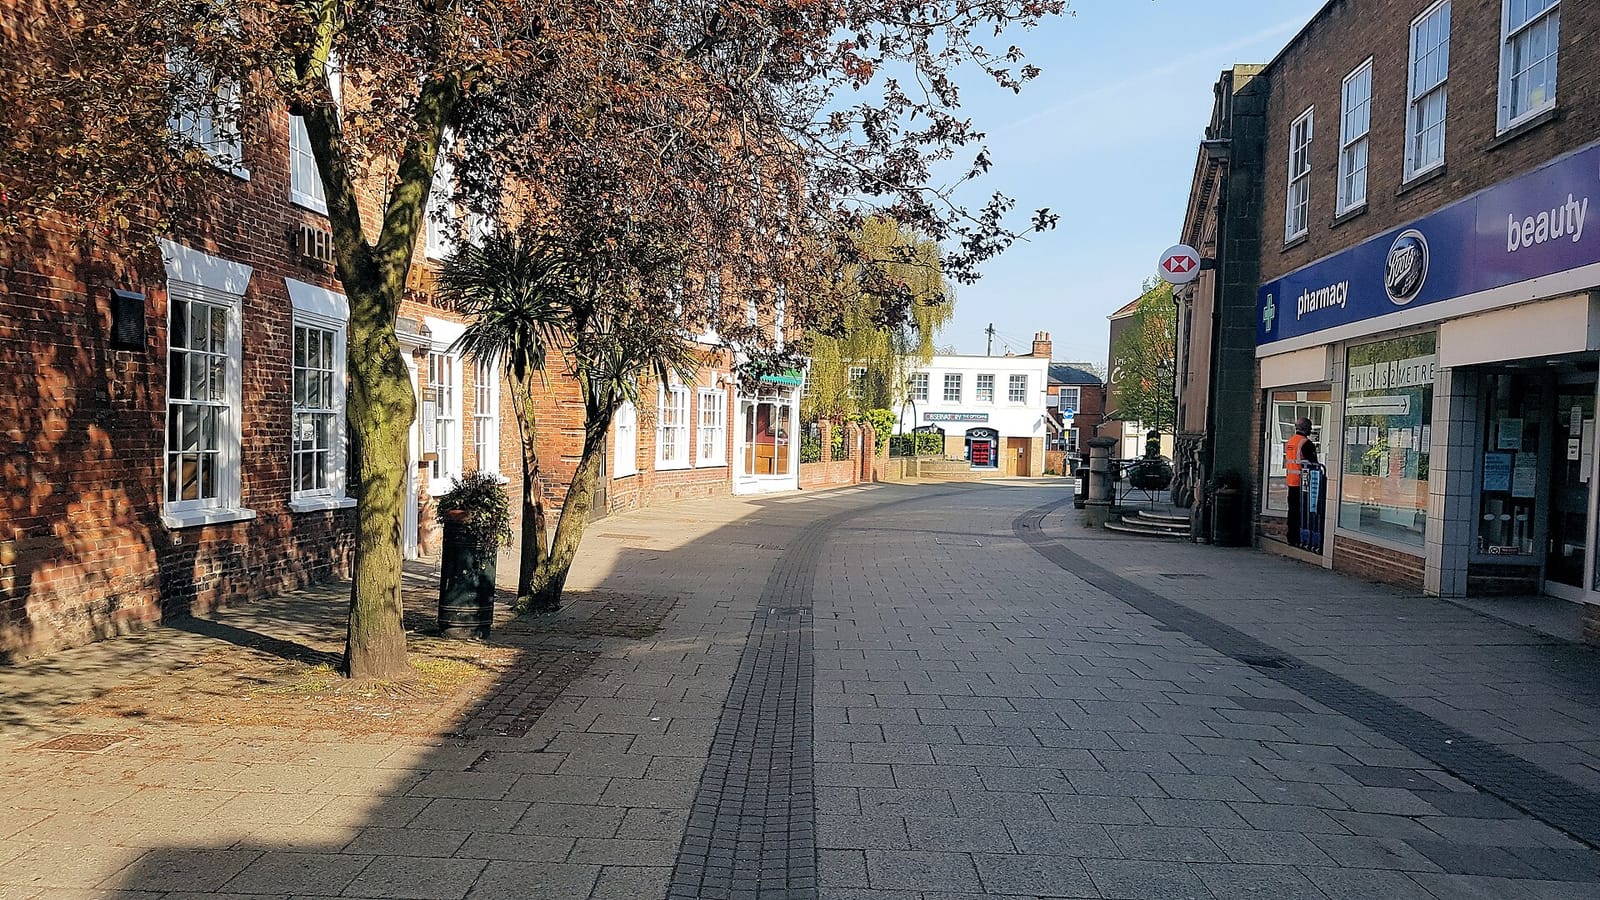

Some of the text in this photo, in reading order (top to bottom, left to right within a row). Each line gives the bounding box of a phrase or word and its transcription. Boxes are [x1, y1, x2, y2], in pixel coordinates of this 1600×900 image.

[1507, 193, 1588, 253] beauty
[1388, 245, 1414, 287] Boots
[1297, 279, 1349, 321] pharmacy
[1350, 371, 1373, 389] THIS
[1376, 370, 1387, 386] IS
[1390, 368, 1396, 385] 2
